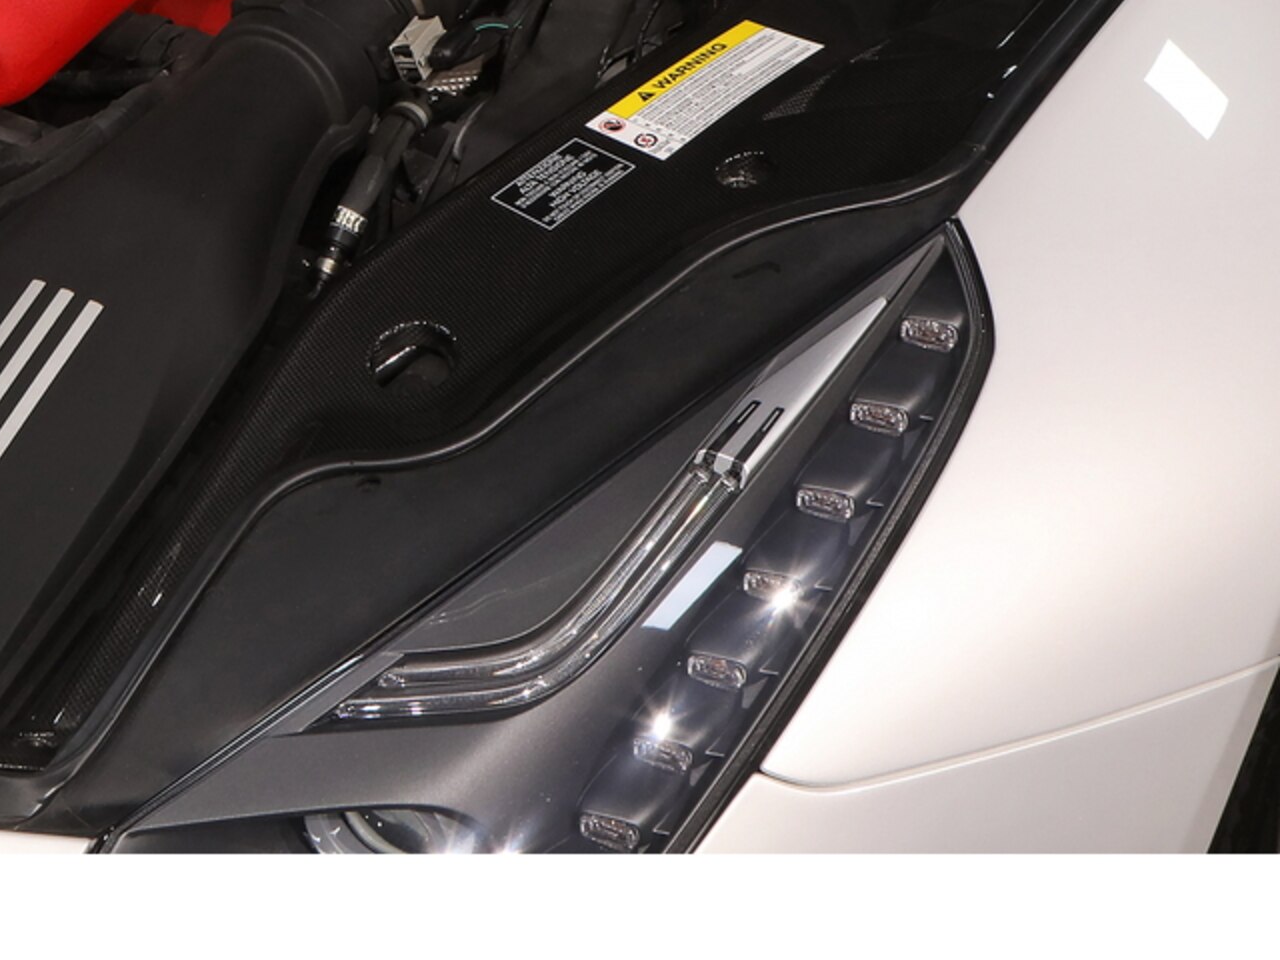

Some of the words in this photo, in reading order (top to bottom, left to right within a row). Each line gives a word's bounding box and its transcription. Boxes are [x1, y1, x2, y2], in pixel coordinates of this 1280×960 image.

[654, 42, 728, 89] WARNING
[548, 171, 587, 197] WARNING
[570, 169, 602, 193] VOLTAGE
